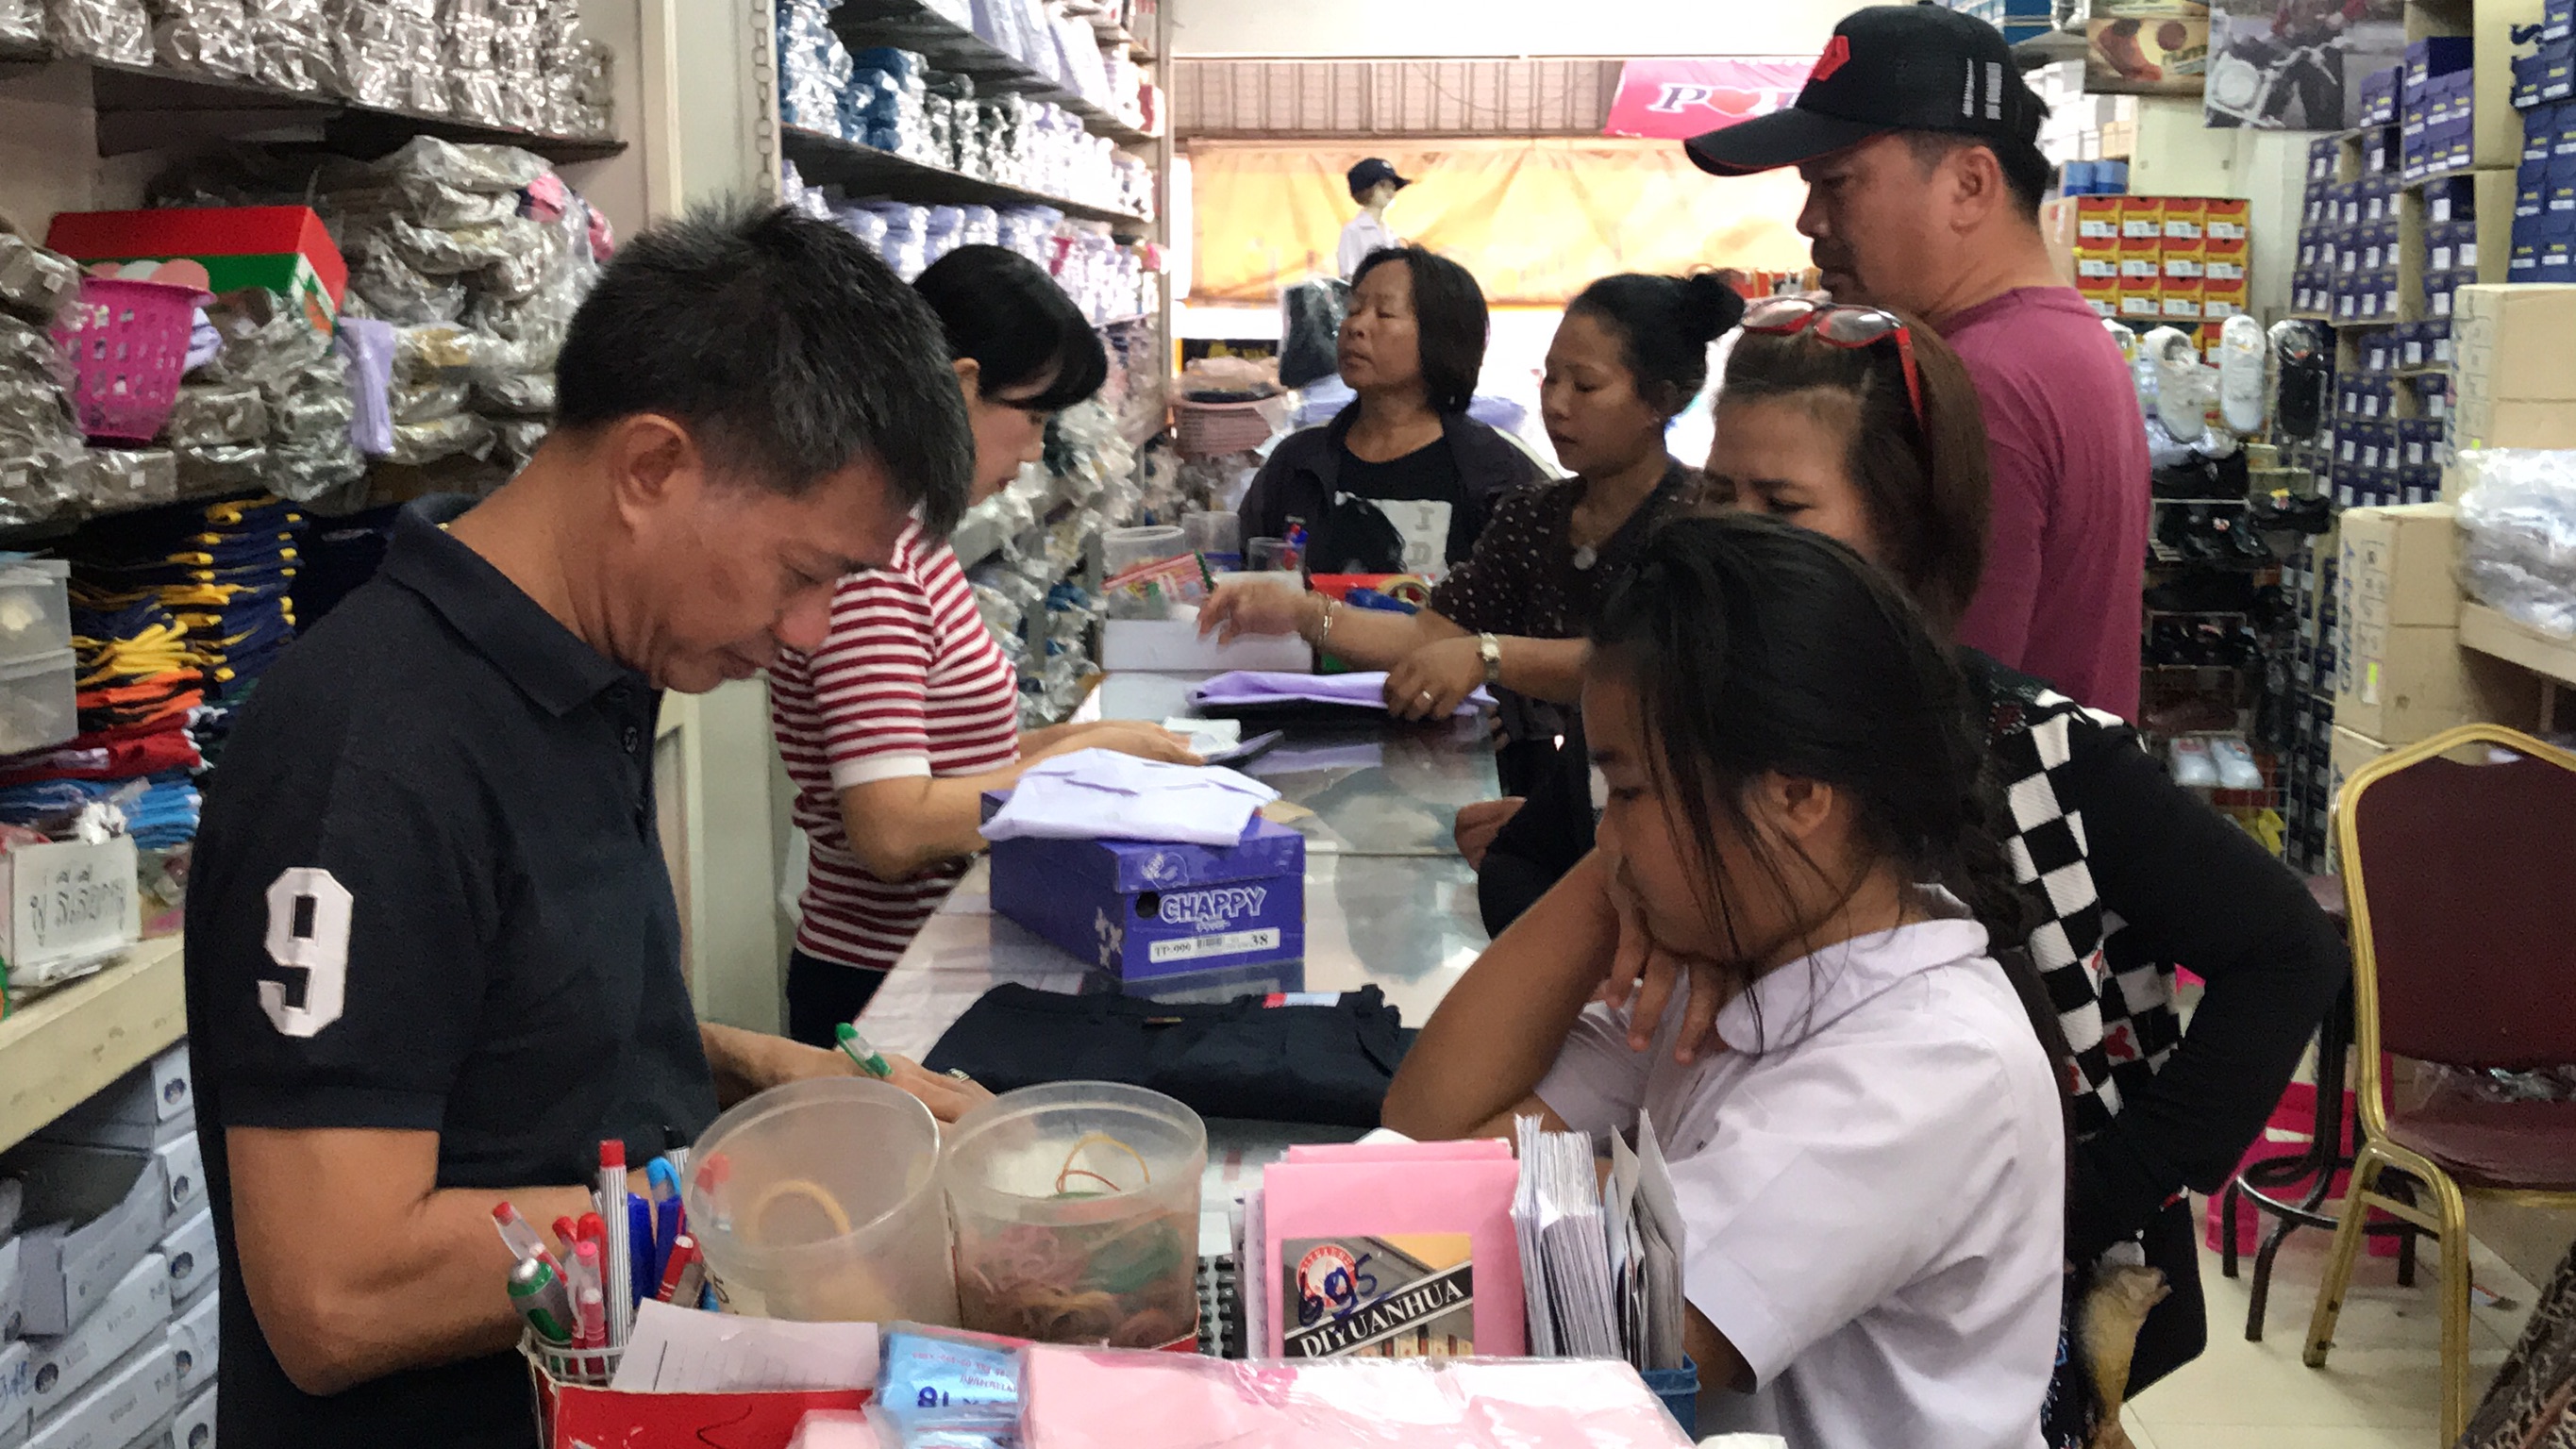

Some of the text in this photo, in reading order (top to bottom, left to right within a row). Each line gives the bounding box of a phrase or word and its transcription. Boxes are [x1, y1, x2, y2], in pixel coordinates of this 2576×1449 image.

[1161, 886, 1267, 924] CHAPPY
[257, 867, 354, 1037] 9
[1299, 1278, 1464, 1358] DIYUANHUA
